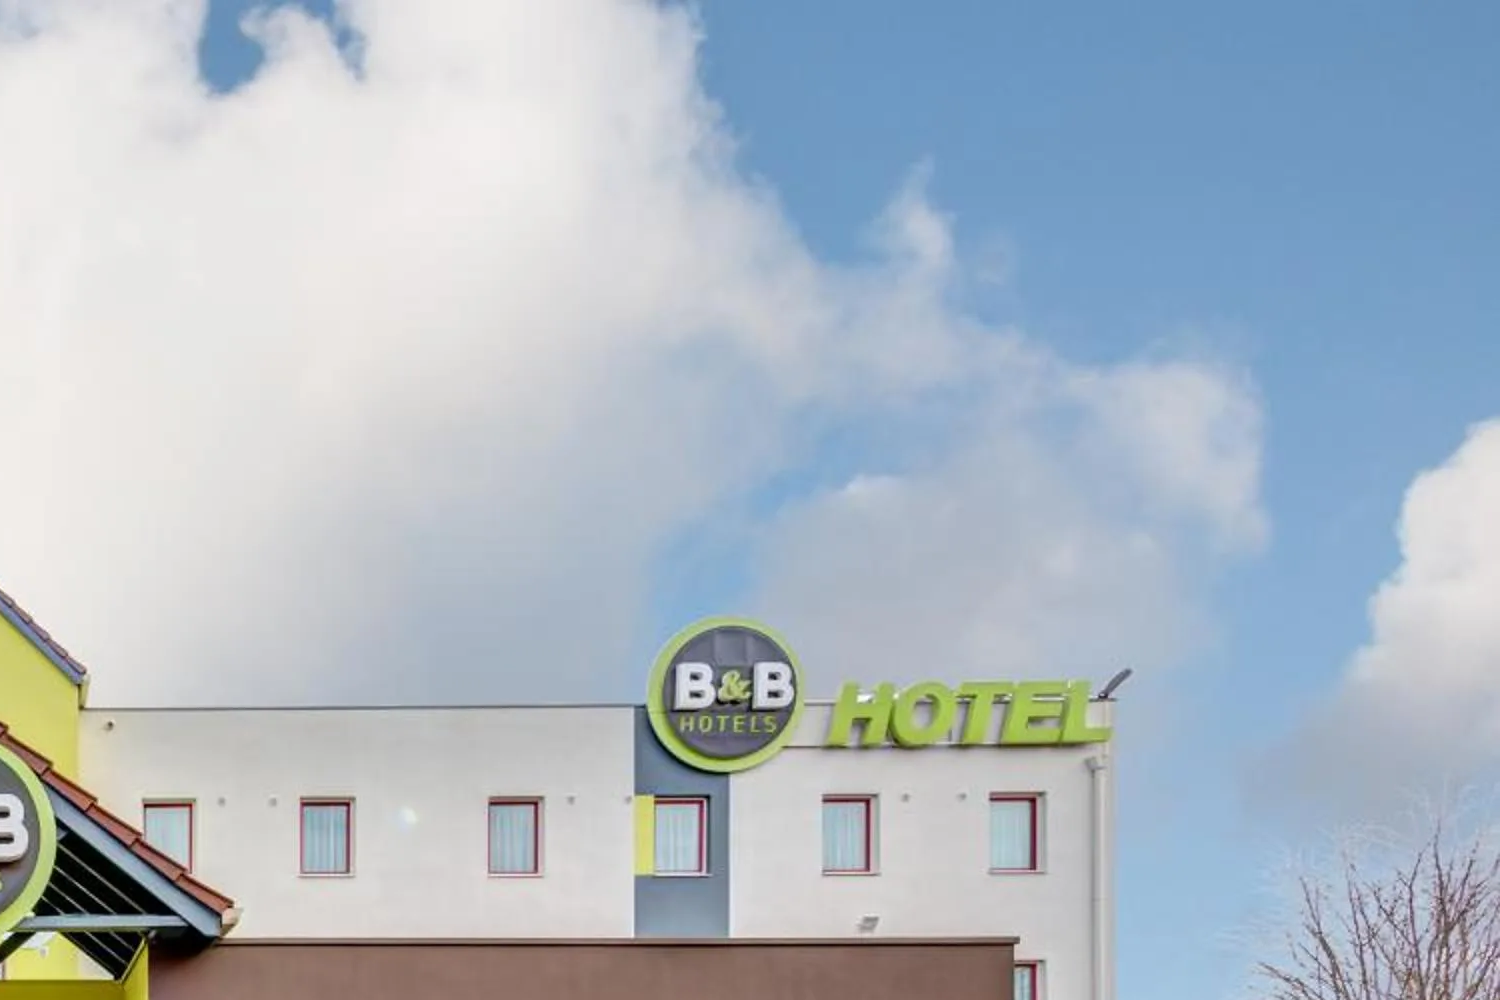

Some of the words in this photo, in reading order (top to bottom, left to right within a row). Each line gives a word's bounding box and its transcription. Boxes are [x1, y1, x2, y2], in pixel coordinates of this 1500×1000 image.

[673, 661, 795, 712] B&B
[679, 714, 778, 734] HOTELS
[825, 680, 1114, 748] HOTEL
